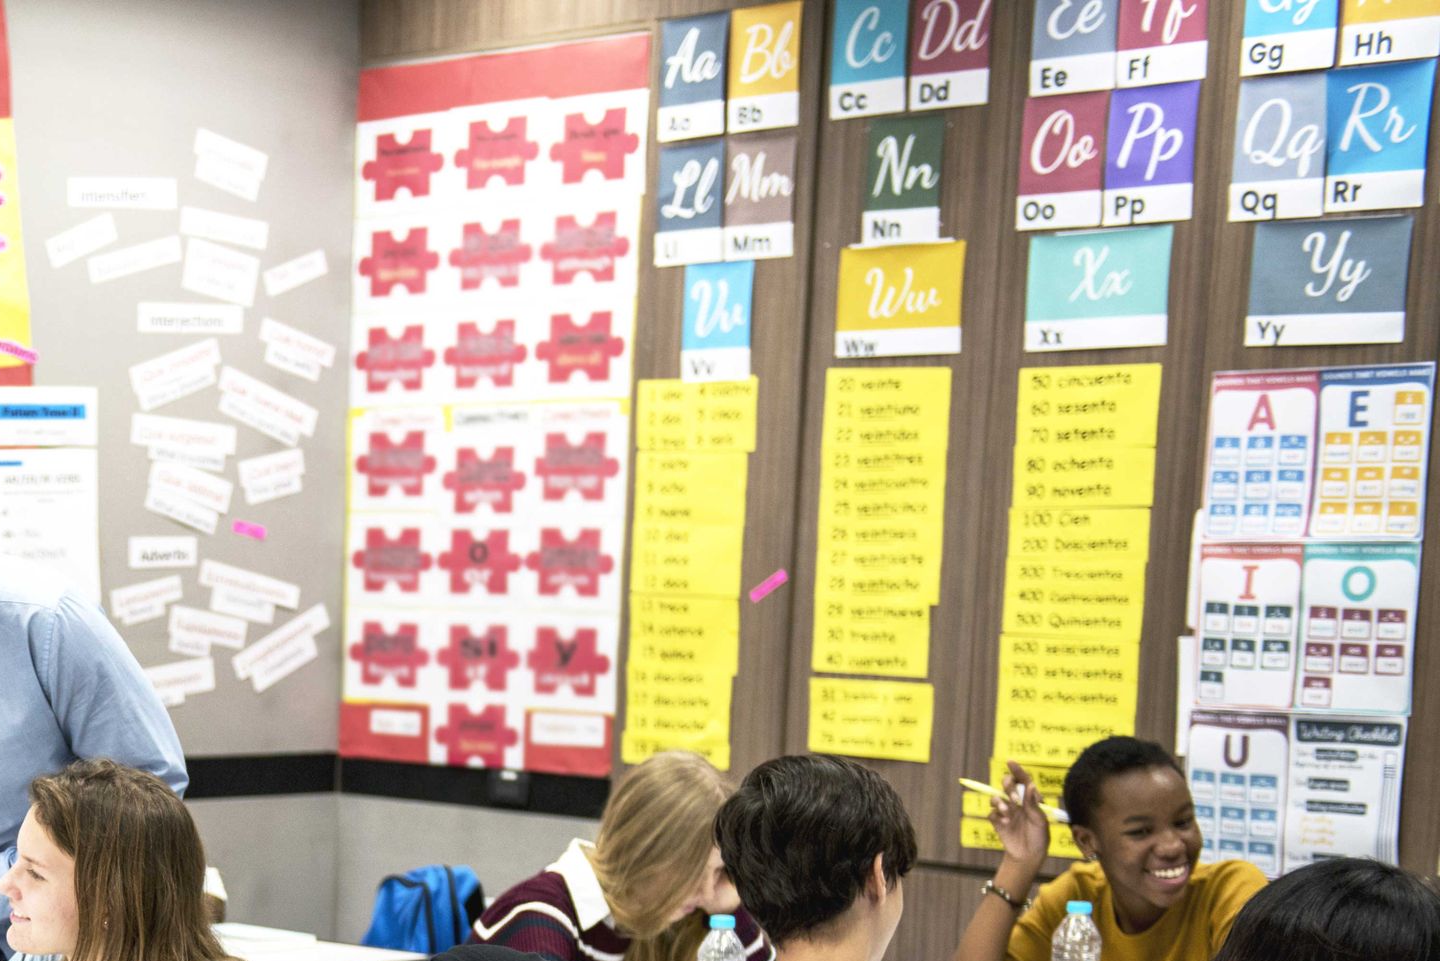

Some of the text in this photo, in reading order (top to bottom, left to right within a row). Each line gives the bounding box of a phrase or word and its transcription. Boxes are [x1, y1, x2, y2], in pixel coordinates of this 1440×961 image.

[845, 5, 895, 69] Cc
[917, 0, 989, 62] Dd
[1354, 31, 1393, 57] Hh
[664, 26, 722, 90] Aa
[739, 20, 795, 85] Bb
[1127, 54, 1152, 80] Ff
[1248, 42, 1285, 70] Gg
[920, 80, 950, 104] Dd
[1040, 67, 1068, 89] Ee
[839, 92, 867, 113] Cc
[1339, 82, 1418, 153] Rr
[1030, 109, 1099, 176] Oo
[1116, 101, 1184, 182] Pp
[1242, 97, 1325, 178] Qq
[724, 151, 793, 204] Mm
[871, 133, 940, 199] Nn
[661, 157, 720, 220] Ll
[1240, 189, 1278, 221] Qq
[1333, 179, 1362, 204] Rr
[1022, 200, 1056, 222] Oo
[1114, 194, 1146, 224] Pp
[872, 219, 902, 239] Nn
[1067, 244, 1134, 303] Xx
[1302, 228, 1373, 303] Yy
[691, 278, 746, 339] Vv
[864, 266, 942, 320] Ww
[1257, 320, 1287, 347] Yy
[1030, 373, 1053, 390] 50
[1246, 393, 1277, 432] A
[1348, 389, 1371, 429] E
[1030, 425, 1050, 444] 70
[1023, 511, 1053, 528] 100
[1237, 564, 1260, 602] I
[1340, 565, 1378, 603] O
[1222, 733, 1251, 770] U
